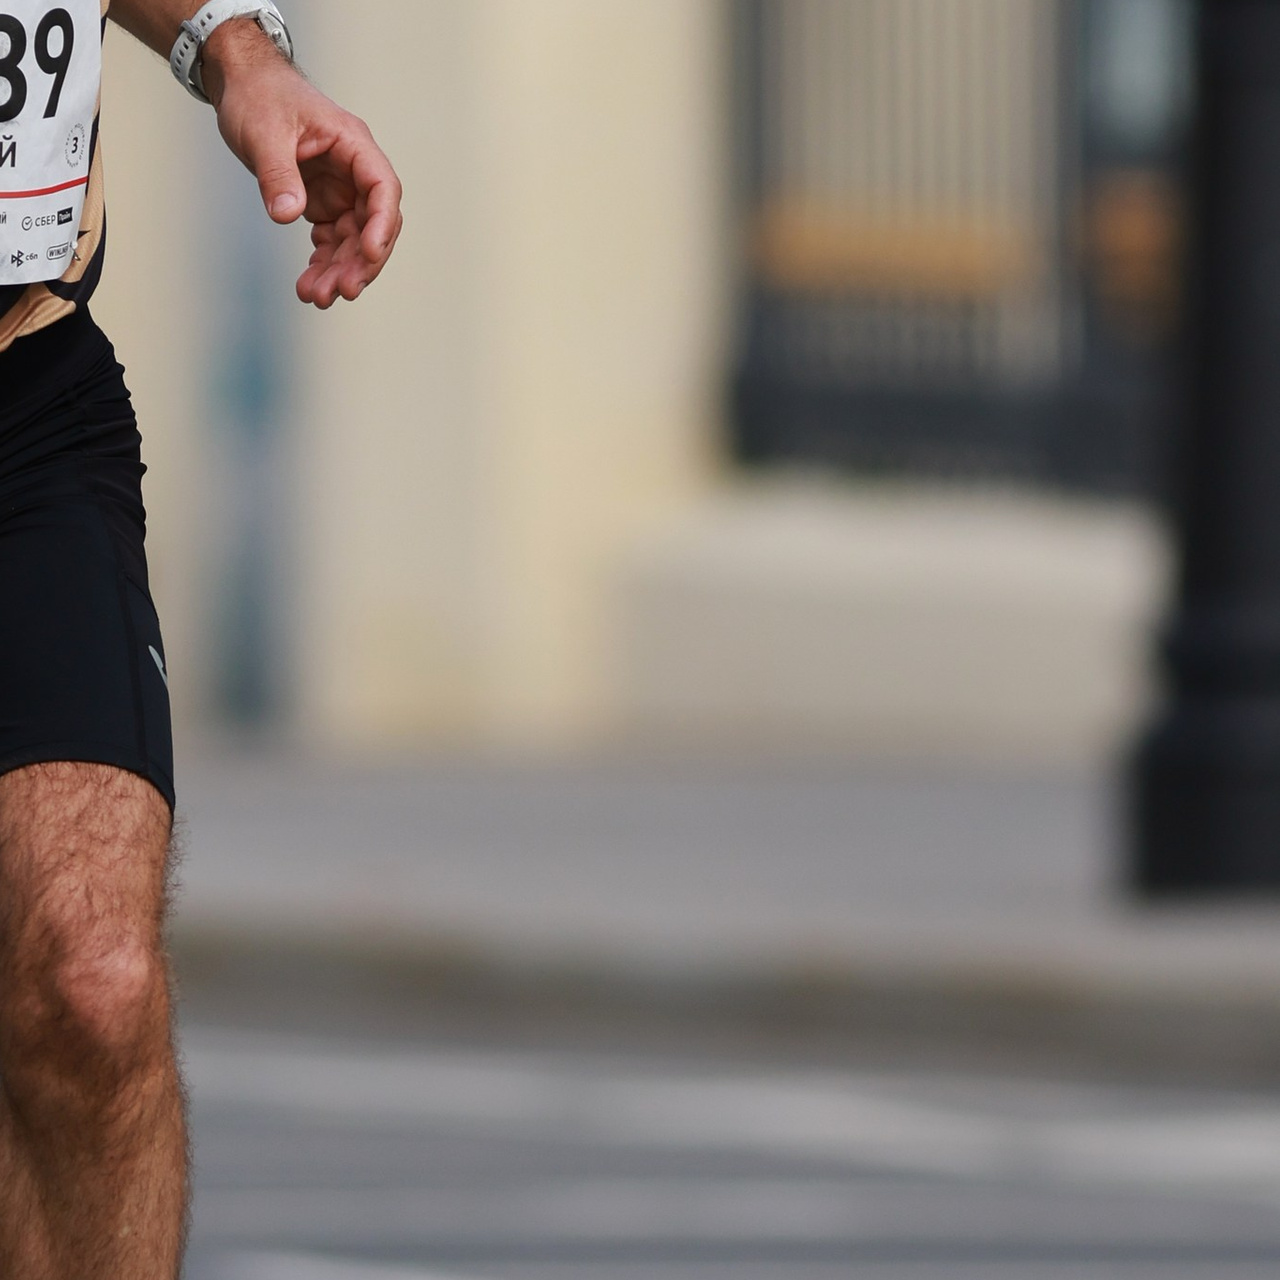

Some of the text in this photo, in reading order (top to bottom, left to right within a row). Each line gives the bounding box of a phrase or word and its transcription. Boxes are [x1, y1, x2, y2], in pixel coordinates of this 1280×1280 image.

[71, 136, 79, 154] 3
[35, 214, 57, 227] СБЕР
[25, 252, 39, 261] сбп
